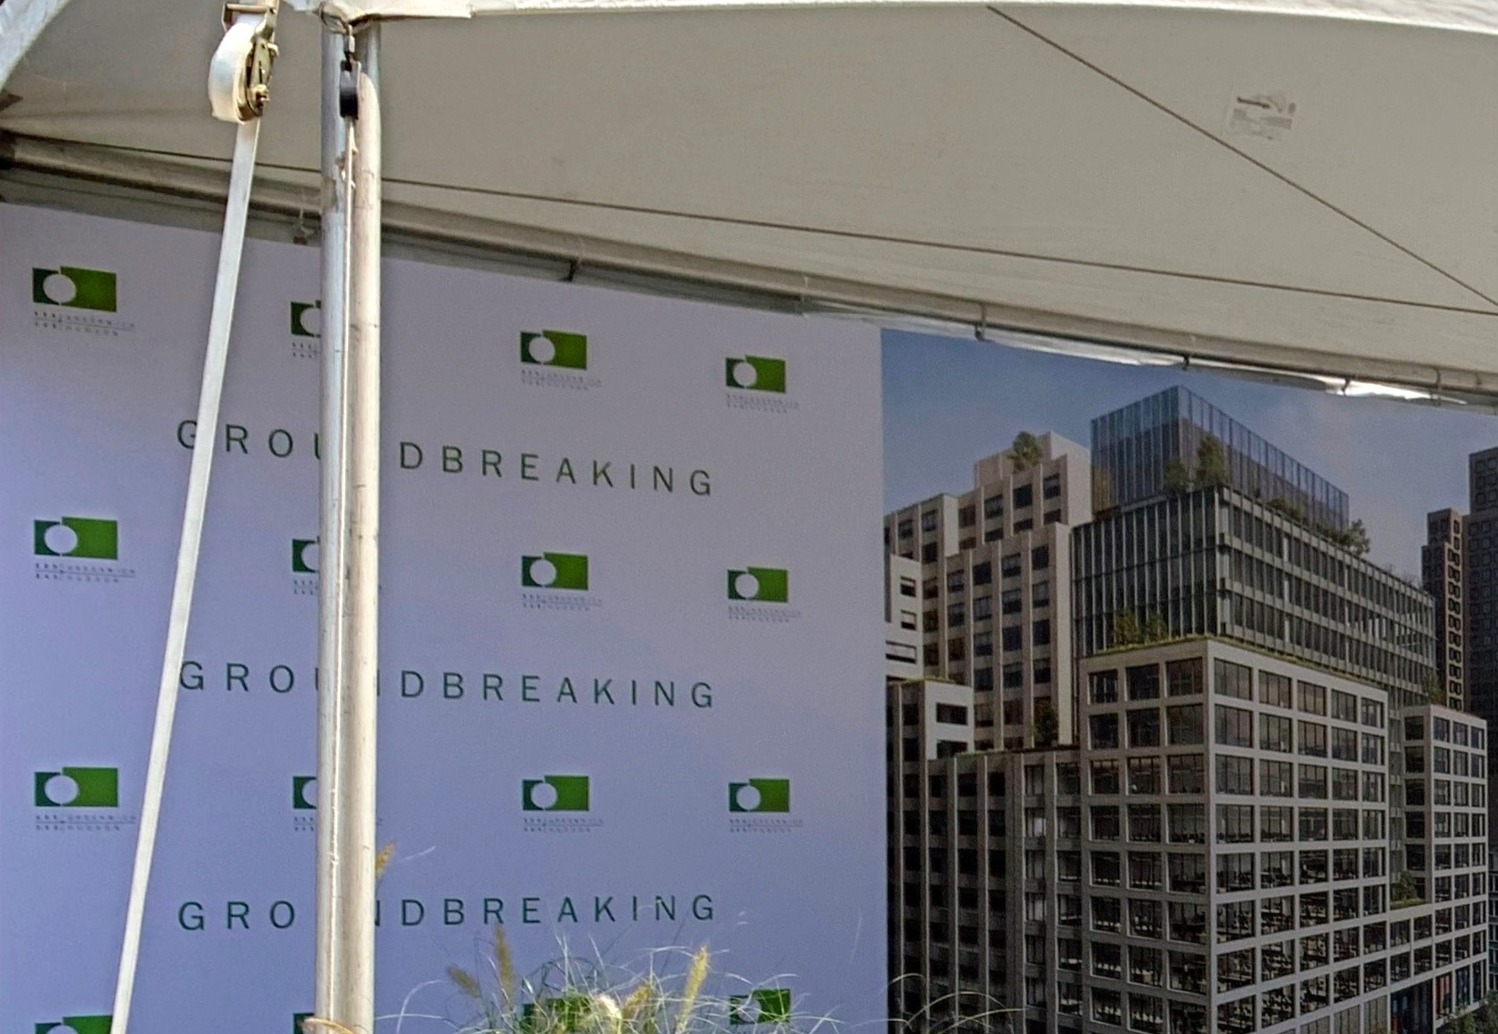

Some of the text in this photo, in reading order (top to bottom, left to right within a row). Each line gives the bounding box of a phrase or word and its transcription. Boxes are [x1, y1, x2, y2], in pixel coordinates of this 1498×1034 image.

[176, 419, 712, 497] GRODBREAKING
[179, 659, 714, 709] GRODBREAKING
[177, 893, 714, 931] GRODBREAKING
